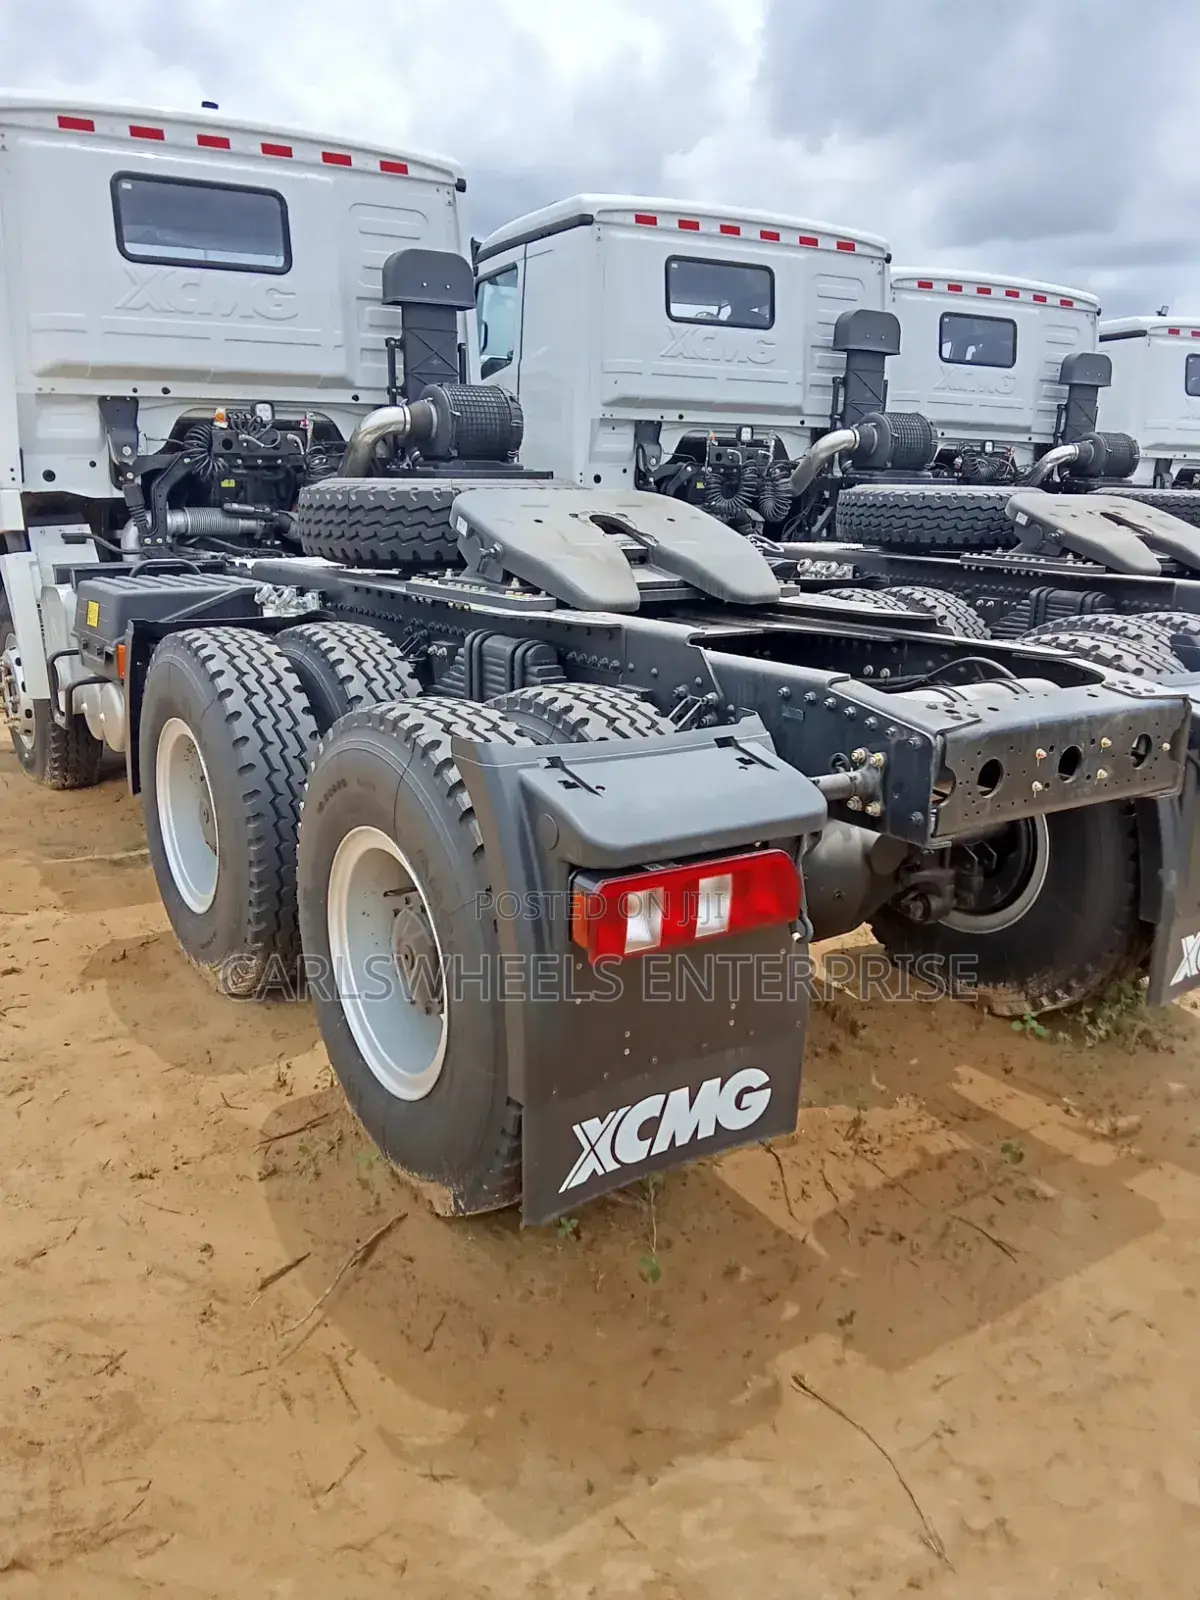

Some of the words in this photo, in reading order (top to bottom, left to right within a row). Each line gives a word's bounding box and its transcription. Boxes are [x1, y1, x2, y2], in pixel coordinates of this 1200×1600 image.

[114, 265, 299, 321] XCMG
[659, 324, 777, 365] XCMG
[558, 1067, 772, 1193] XCMG
